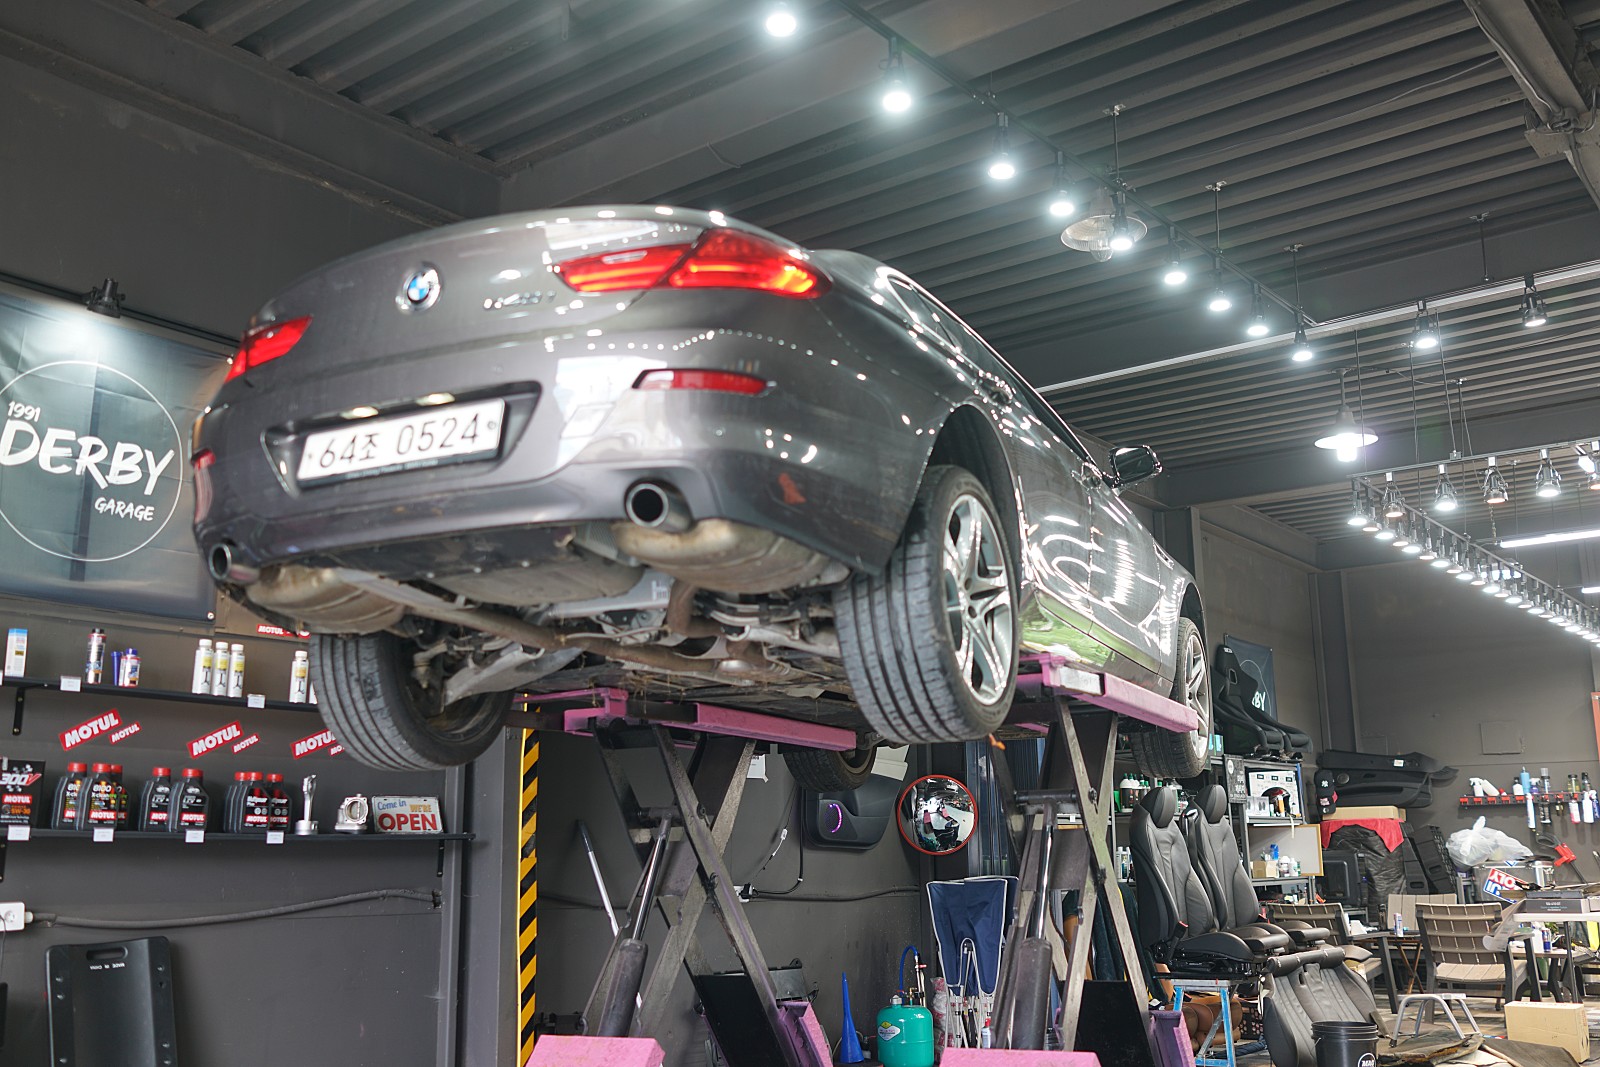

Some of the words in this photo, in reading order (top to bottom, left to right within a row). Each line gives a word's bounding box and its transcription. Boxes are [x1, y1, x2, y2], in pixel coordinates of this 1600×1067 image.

[8, 401, 41, 422] 1991
[396, 412, 479, 456] 0524
[0, 419, 175, 496] DERBY
[95, 497, 155, 521] GARAGE
[258, 625, 284, 635] MOTUL
[1251, 690, 1266, 712] BY
[64, 712, 119, 748] MOTUL
[111, 723, 140, 743] MOTUL
[192, 724, 240, 756] MOTUL
[233, 735, 259, 753] MOTUL
[0, 773, 42, 785] 300V
[4, 795, 30, 804] MOTUL
[378, 801, 398, 811] Come
[399, 799, 407, 807] in
[91, 811, 115, 819] MOTUL
[151, 812, 168, 820] MOT
[378, 813, 438, 831] OPEN
[1489, 870, 1520, 891] OLY
